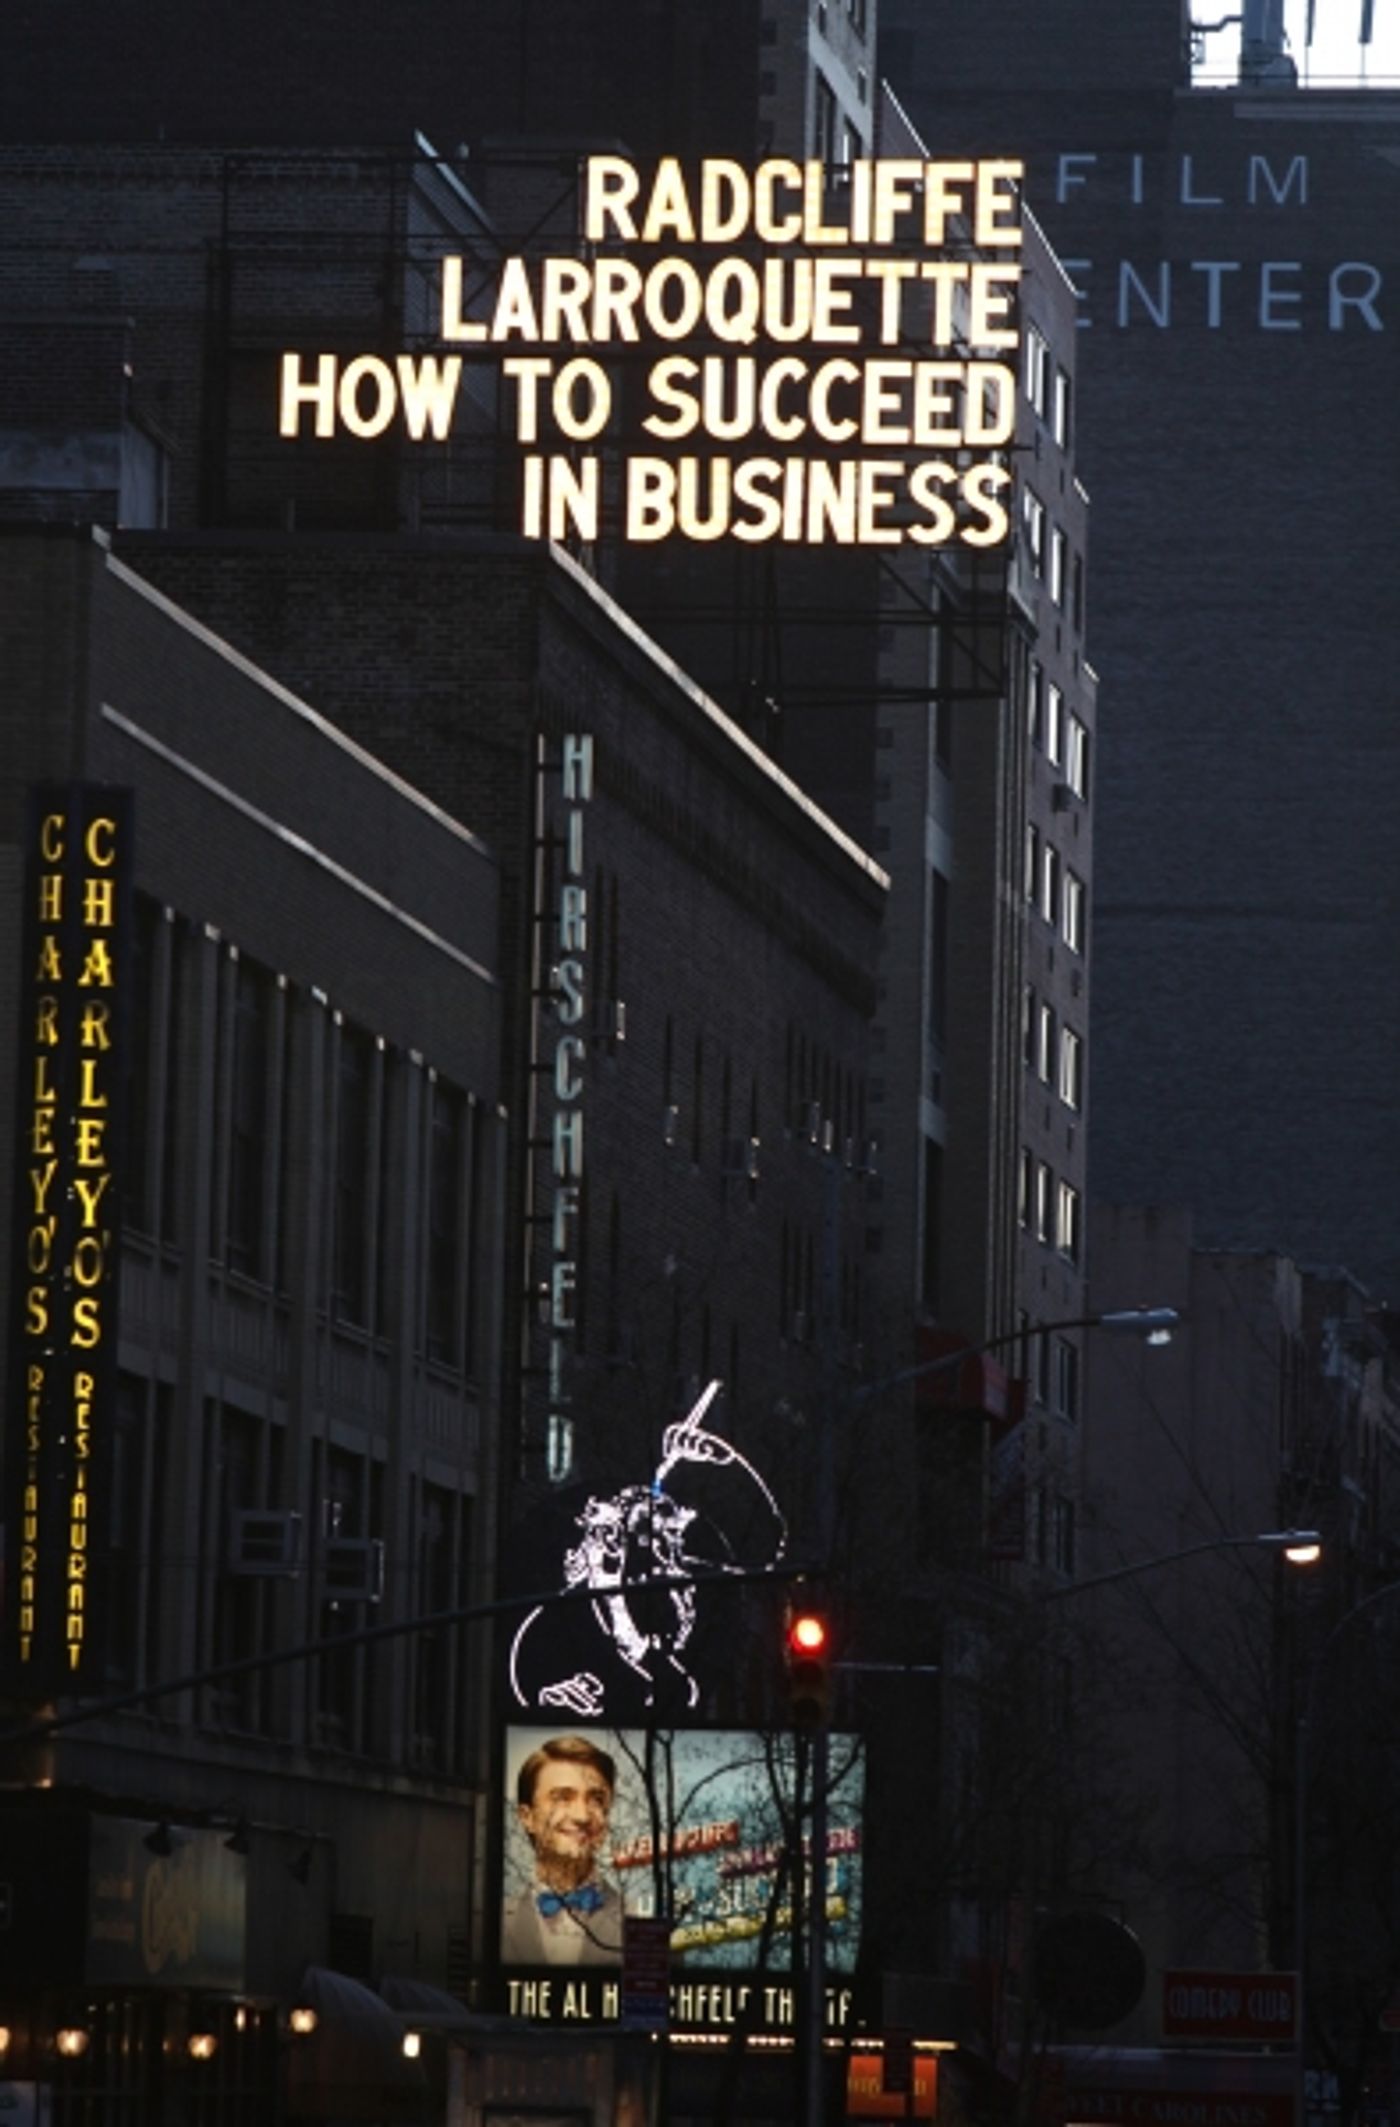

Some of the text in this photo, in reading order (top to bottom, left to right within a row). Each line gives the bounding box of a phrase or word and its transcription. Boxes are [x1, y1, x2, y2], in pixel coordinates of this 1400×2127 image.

[585, 155, 1024, 246] RADCLIFFE
[1056, 153, 1309, 204] FILM
[440, 255, 1021, 348] LARROQUETTE
[1061, 258, 1384, 331] ENTER
[279, 352, 1016, 447] HOW TO SUCCEED
[522, 455, 1011, 548] IN BUSINESS
[545, 732, 594, 1483] HIRSCHFELD
[508, 1980, 551, 2018] THE
[562, 1981, 591, 2018] AL
